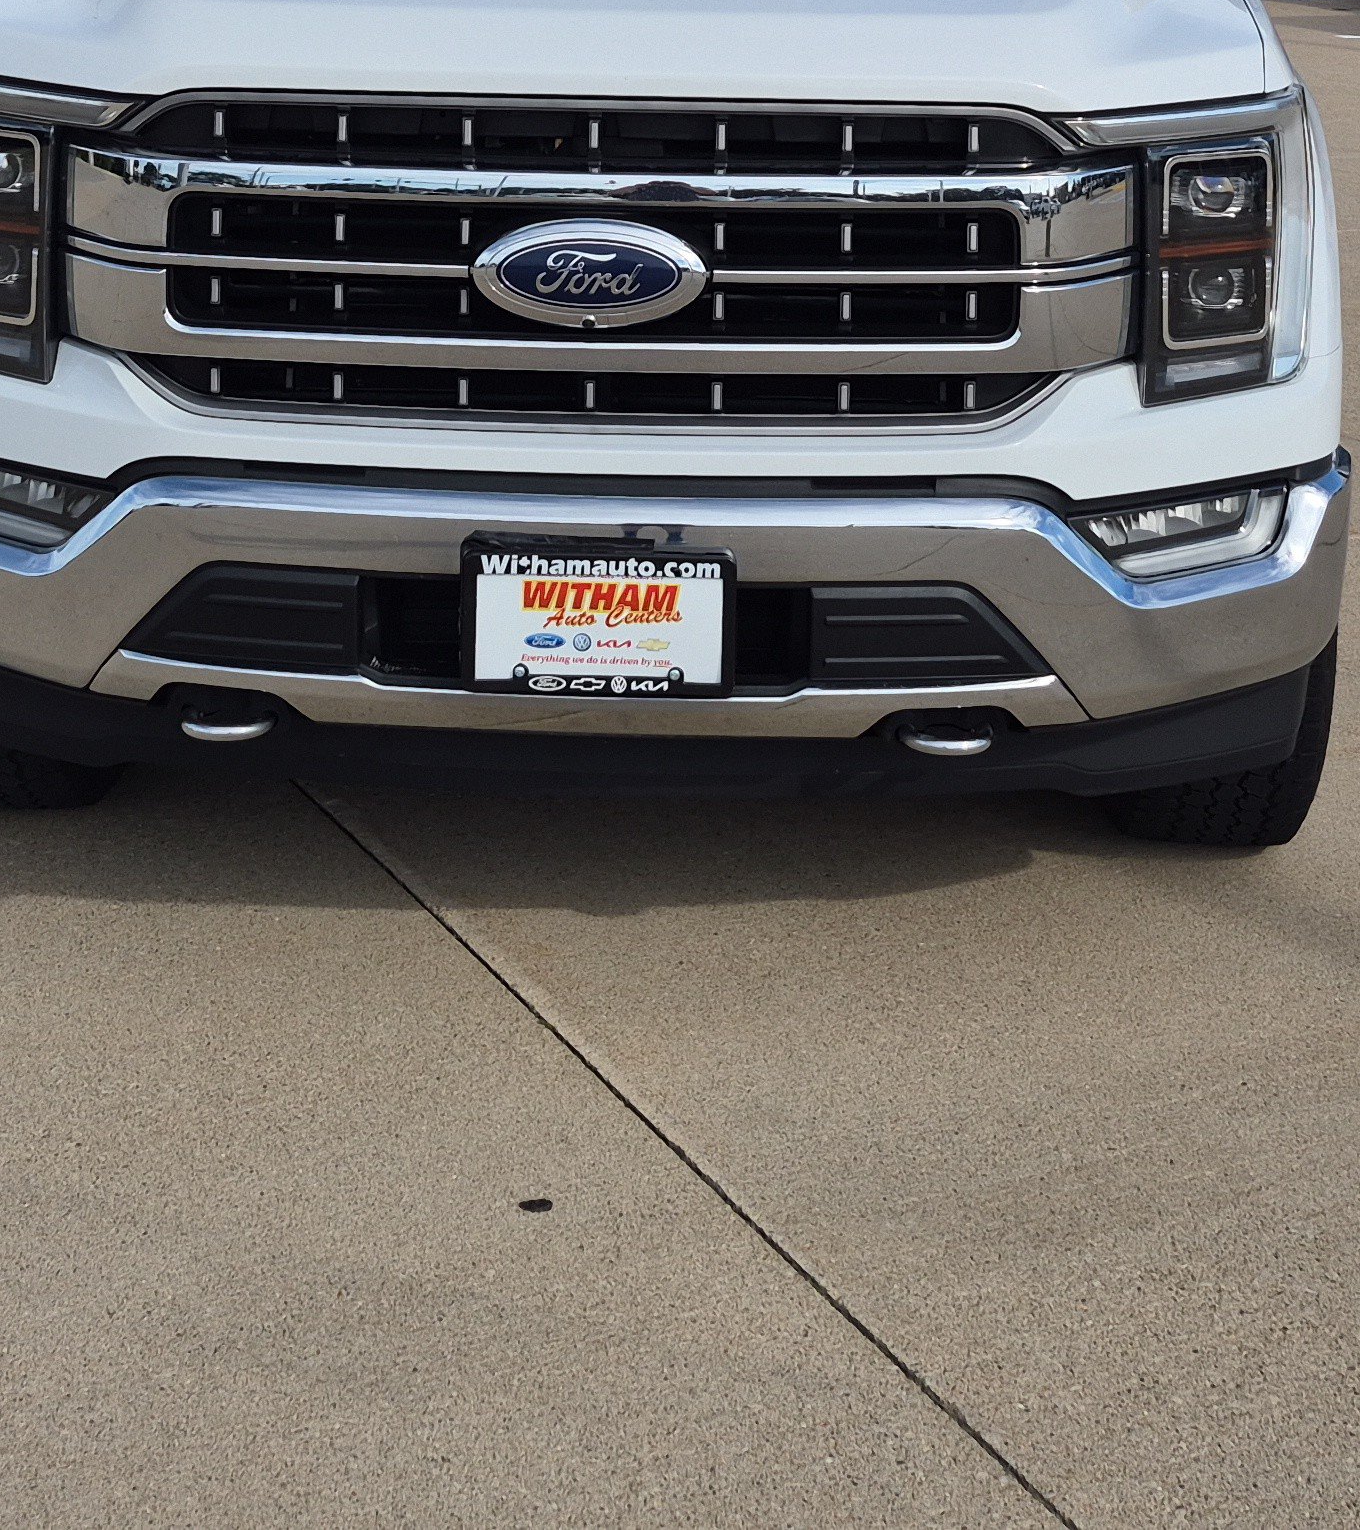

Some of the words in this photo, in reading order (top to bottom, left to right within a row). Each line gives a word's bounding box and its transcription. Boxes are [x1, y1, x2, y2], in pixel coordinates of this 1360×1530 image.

[535, 249, 644, 296] Ford
[481, 554, 721, 578] Withamauto.com
[521, 580, 682, 612] WITHAM
[542, 607, 597, 629] Auto
[605, 604, 683, 628] Centers
[521, 654, 570, 665] Everything
[587, 656, 598, 664] do
[600, 656, 608, 664] is
[609, 657, 639, 665] driven
[641, 657, 651, 667] by
